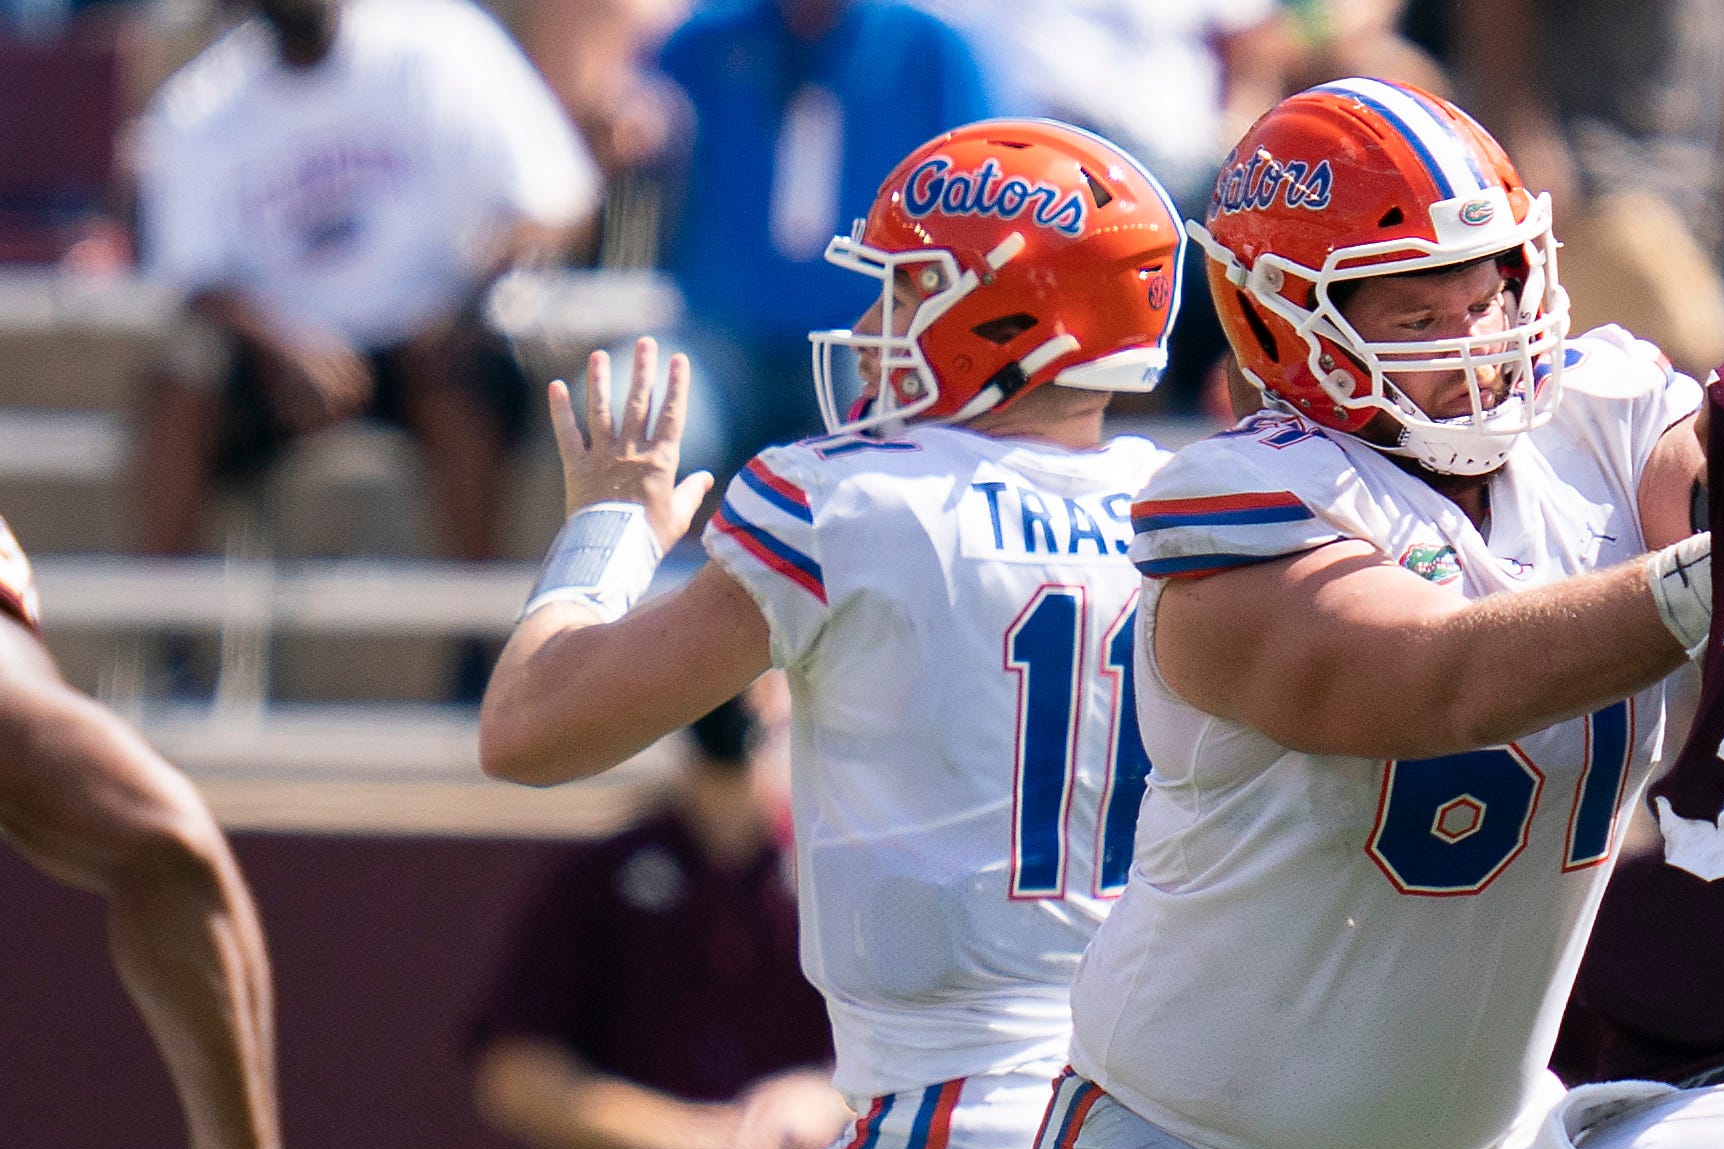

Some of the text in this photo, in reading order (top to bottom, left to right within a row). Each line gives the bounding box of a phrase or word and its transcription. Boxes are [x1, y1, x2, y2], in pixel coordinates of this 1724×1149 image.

[902, 155, 1088, 238] Gators
[971, 482, 1134, 555] TRAS
[1004, 582, 1152, 900] 11
[1363, 696, 1635, 898] 61
